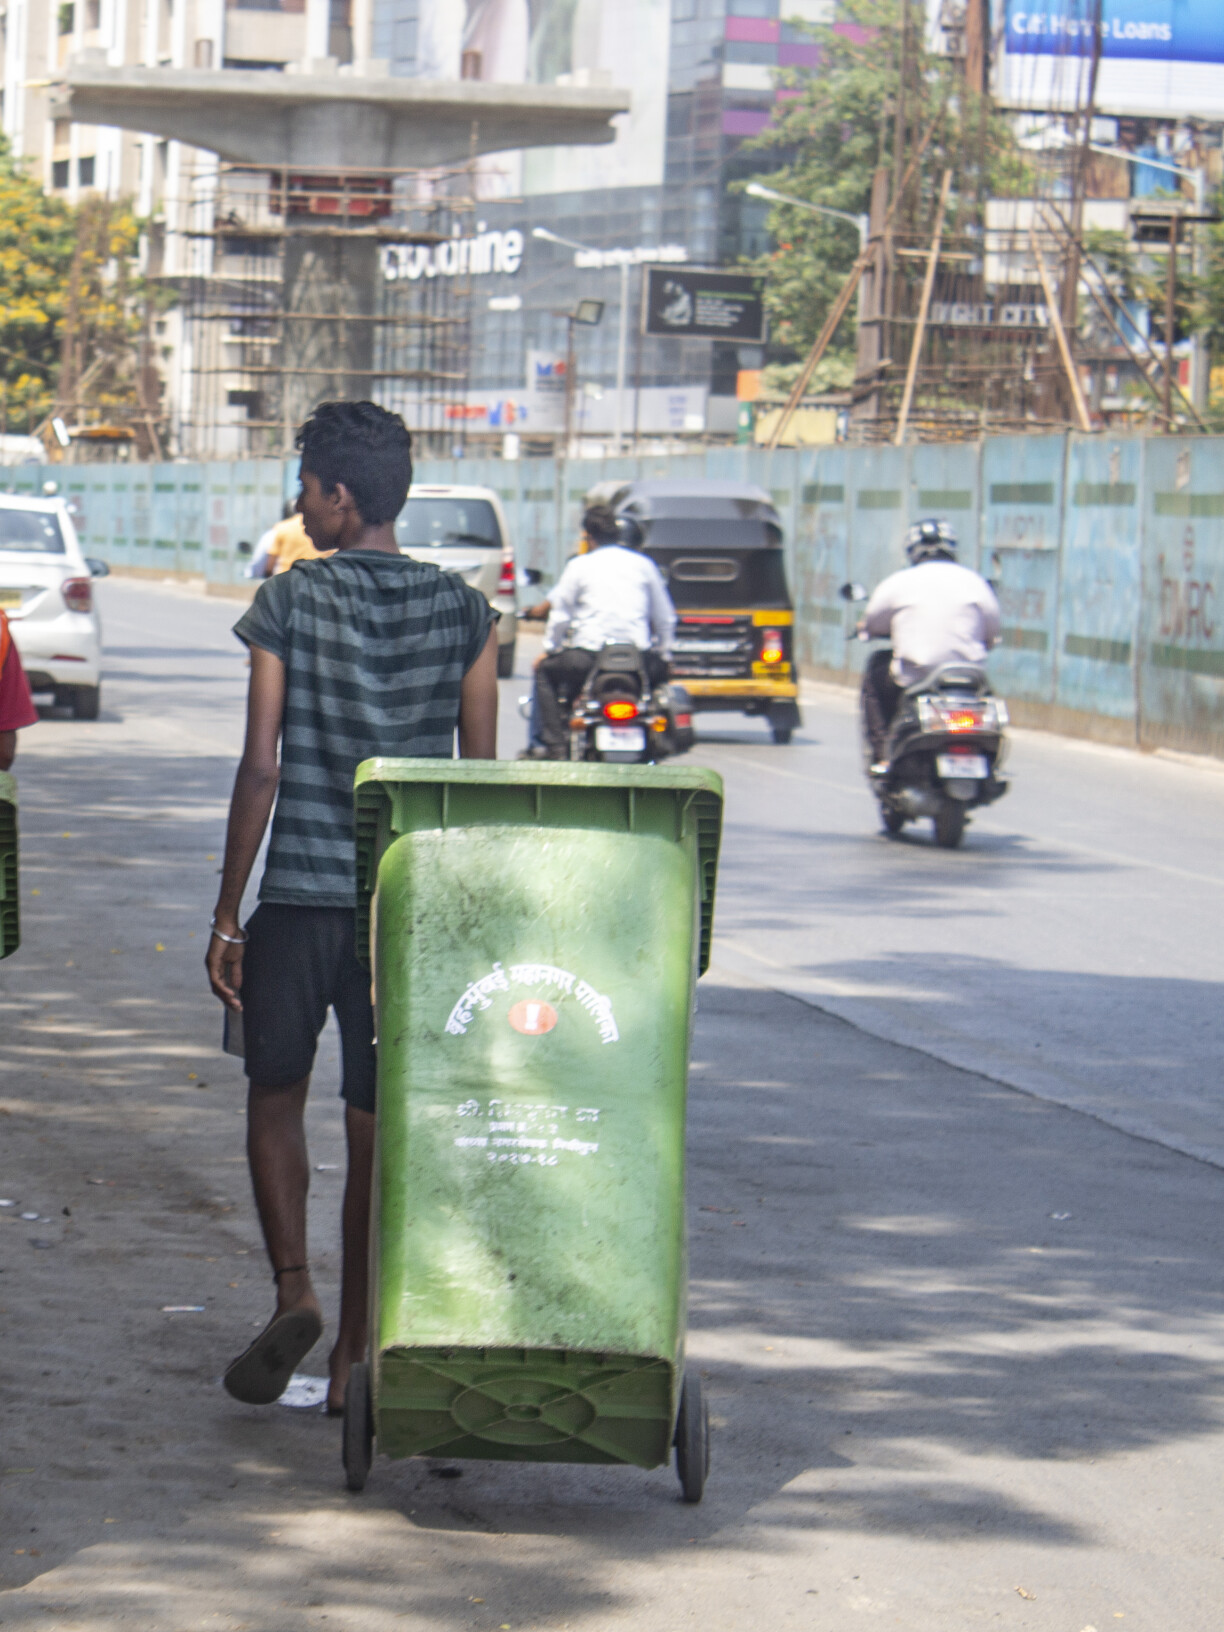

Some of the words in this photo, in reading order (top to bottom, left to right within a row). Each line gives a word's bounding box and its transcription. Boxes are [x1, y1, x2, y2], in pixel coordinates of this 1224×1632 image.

[1113, 18, 1172, 41] Loans
[509, 963, 576, 994] महानगर
[574, 979, 620, 1045] पालिका
